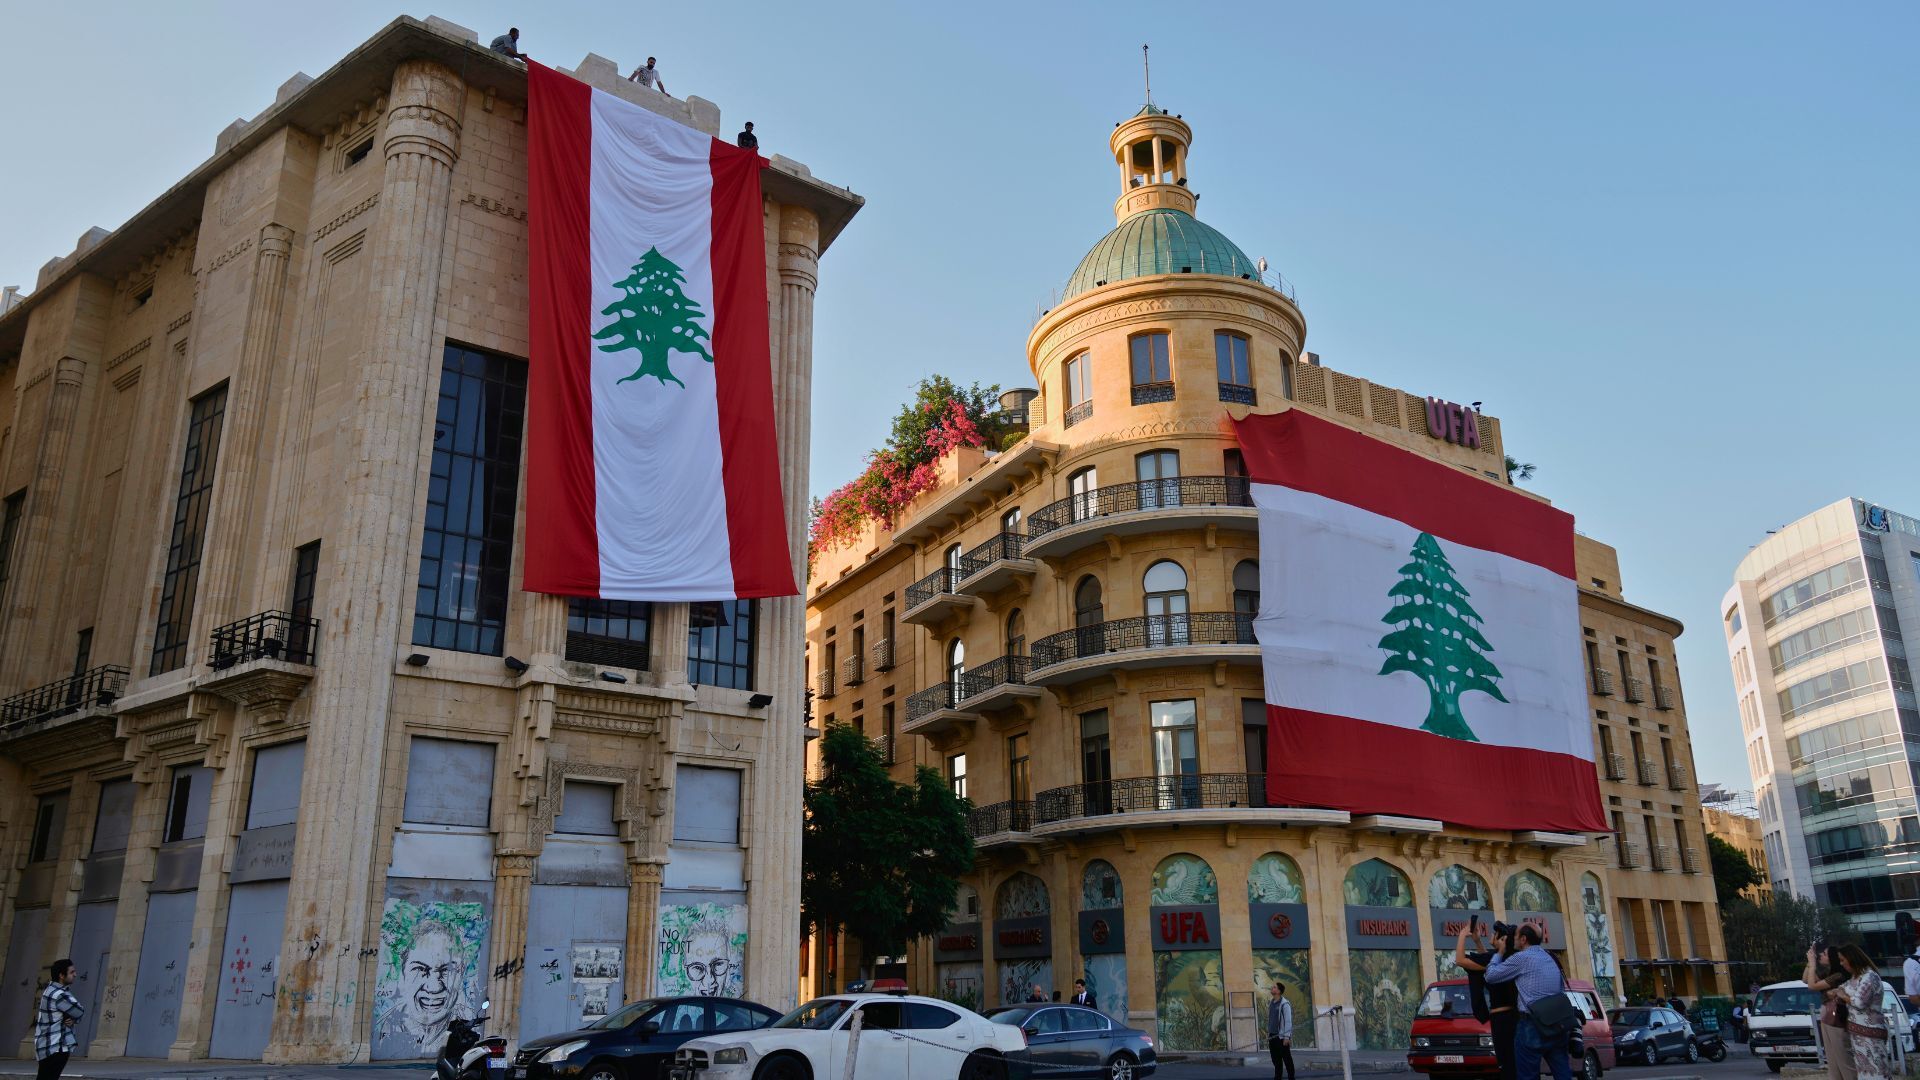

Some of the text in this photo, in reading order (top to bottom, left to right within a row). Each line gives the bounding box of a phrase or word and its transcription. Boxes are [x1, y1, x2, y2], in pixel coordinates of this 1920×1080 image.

[1426, 395, 1481, 449] UFA
[662, 928, 680, 942] NO
[1160, 911, 1210, 944] UFA
[659, 940, 693, 955] TRUST
